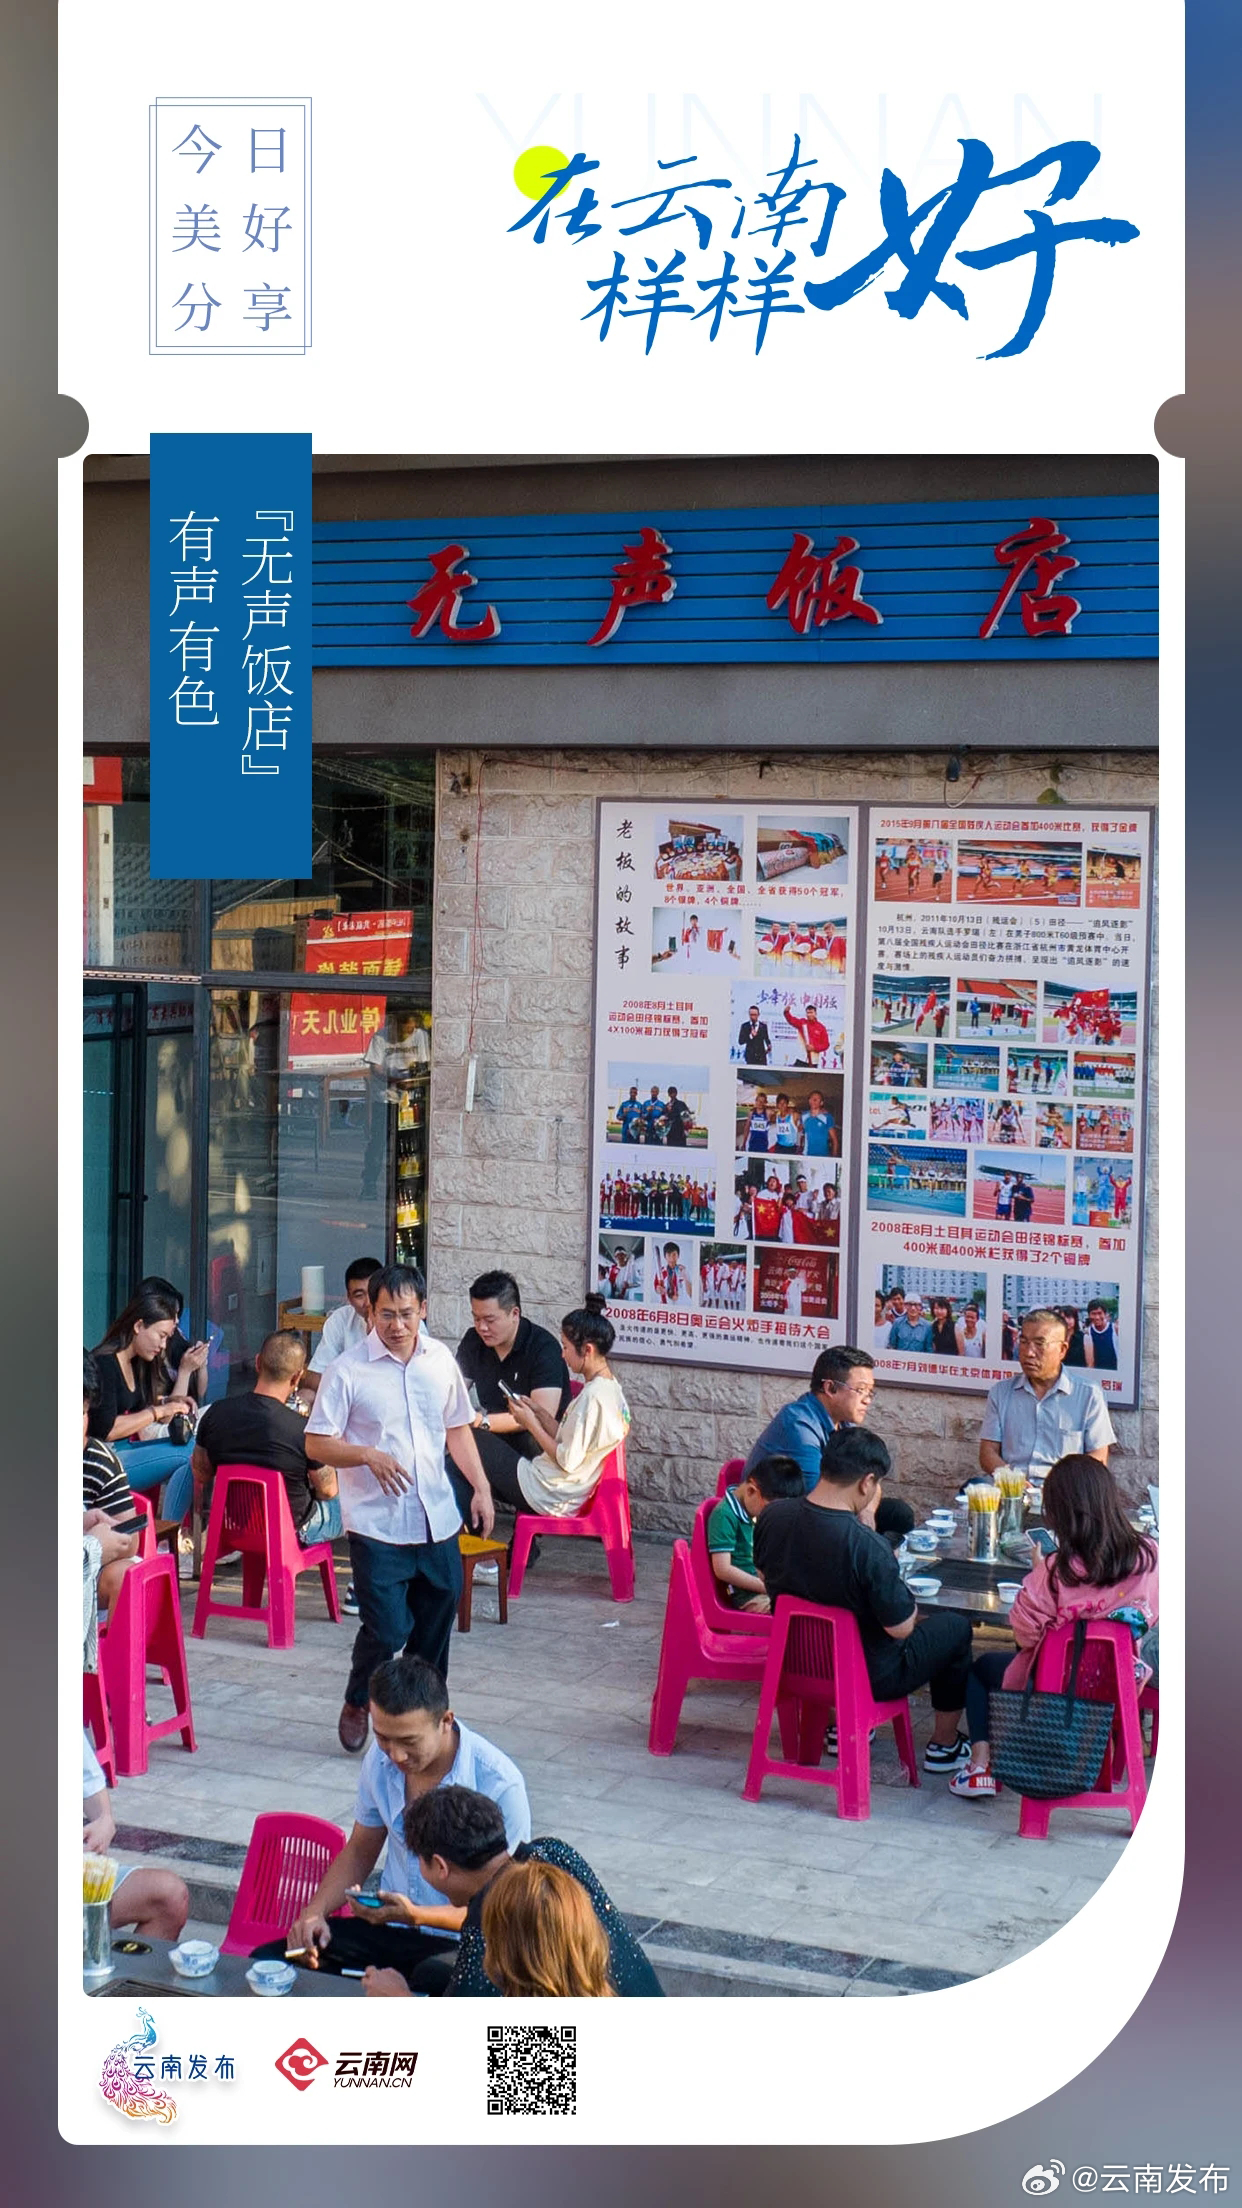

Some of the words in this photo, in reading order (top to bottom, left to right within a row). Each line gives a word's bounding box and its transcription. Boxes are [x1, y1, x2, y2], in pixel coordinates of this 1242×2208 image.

[406, 517, 1082, 647] 无声饭店
[614, 819, 636, 970] 老板的故事
